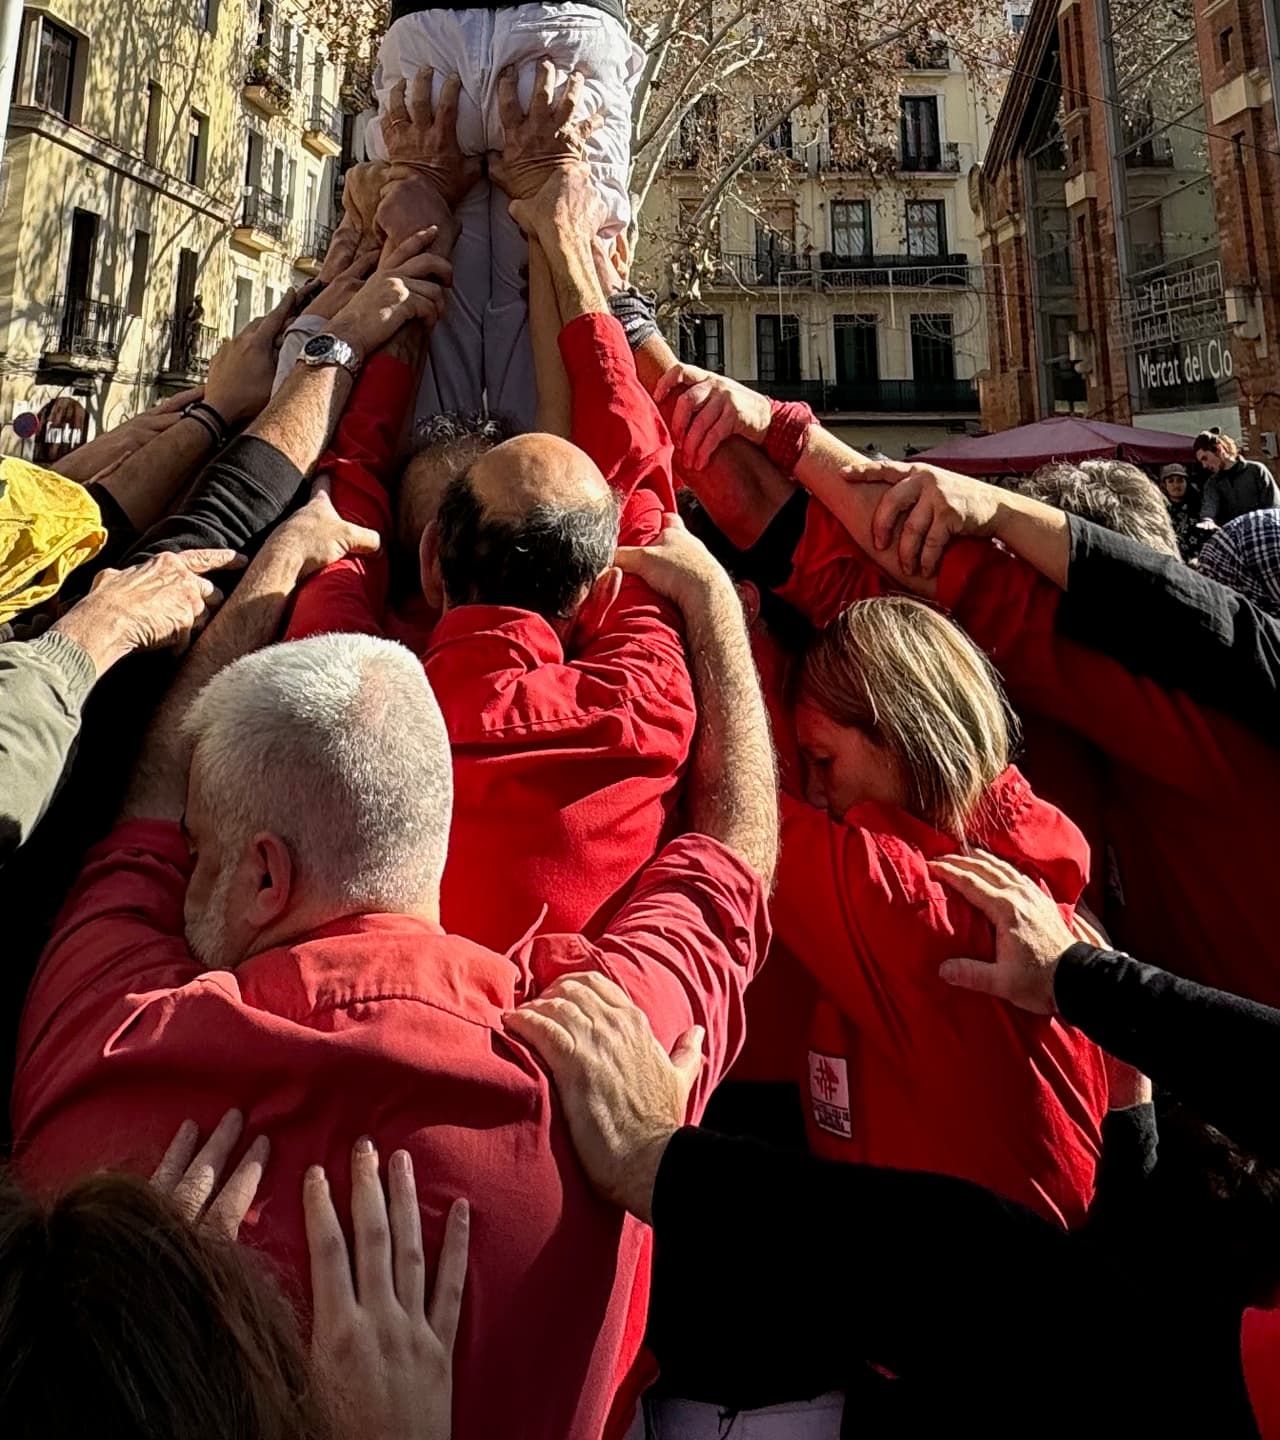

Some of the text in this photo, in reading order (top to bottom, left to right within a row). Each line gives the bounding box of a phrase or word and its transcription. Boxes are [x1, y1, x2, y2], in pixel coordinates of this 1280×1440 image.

[1139, 338, 1233, 390] Mercat del Clo
